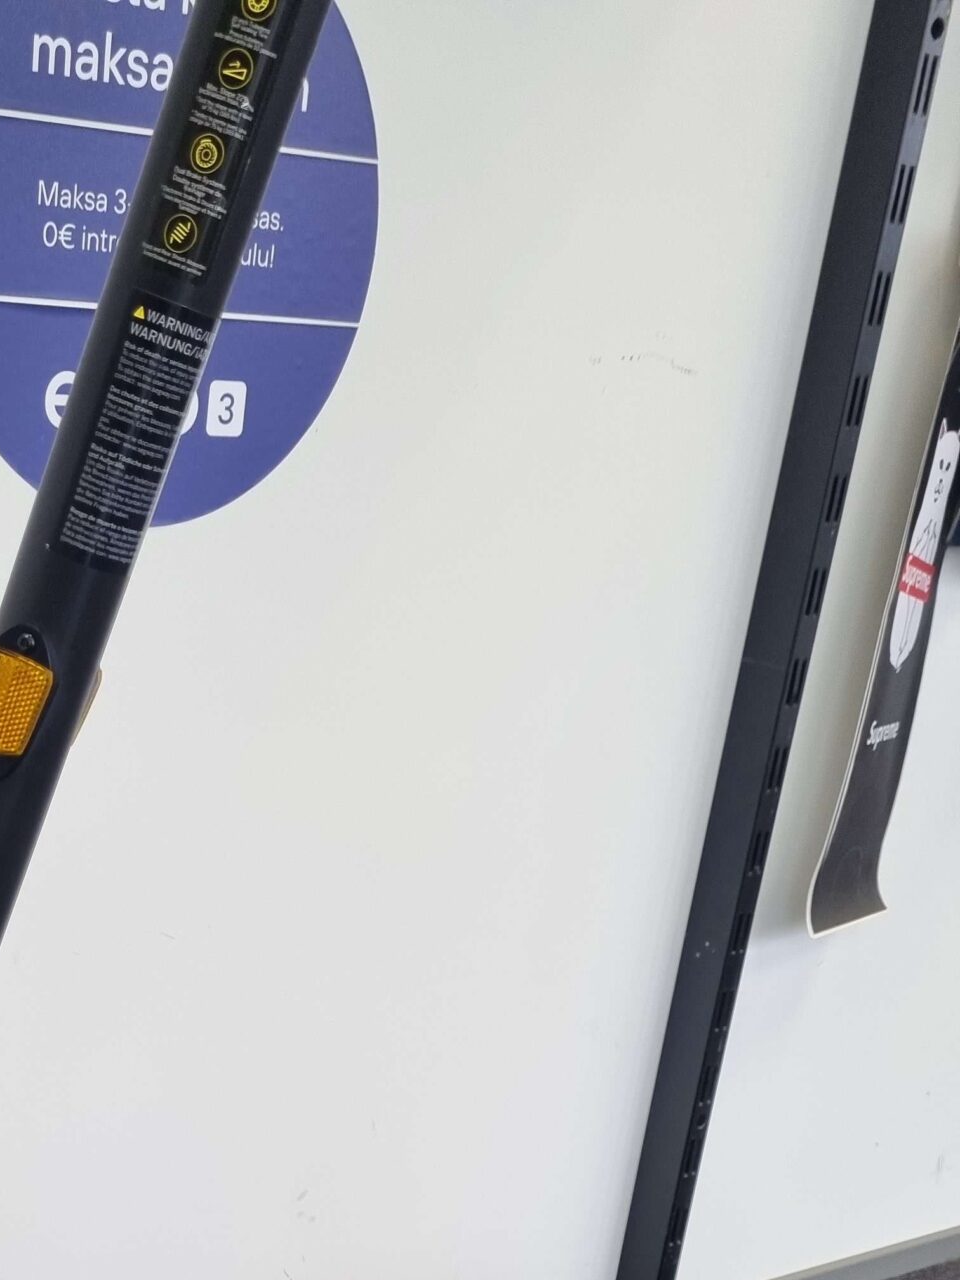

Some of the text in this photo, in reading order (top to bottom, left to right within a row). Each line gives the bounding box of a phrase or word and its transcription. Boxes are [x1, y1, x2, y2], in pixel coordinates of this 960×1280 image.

[32, 31, 174, 92] maksa
[38, 179, 107, 213] Maksa
[43, 221, 76, 249] 0€
[82, 225, 120, 253] intr
[241, 243, 275, 268] ulu!
[218, 393, 235, 425] 3
[866, 720, 901, 751] Supreme
